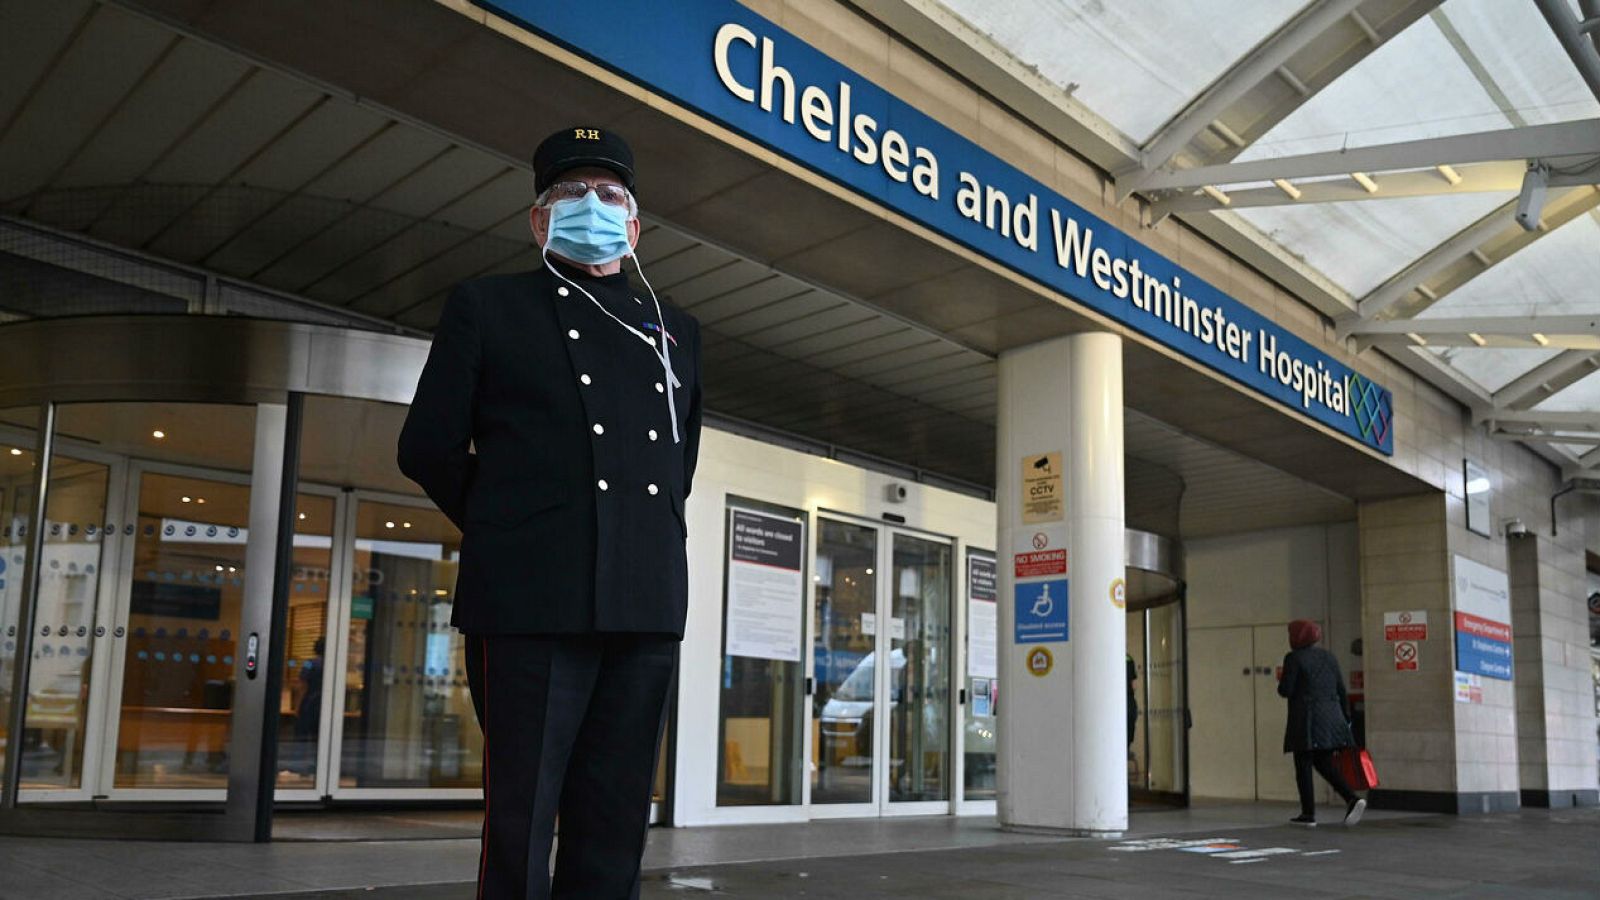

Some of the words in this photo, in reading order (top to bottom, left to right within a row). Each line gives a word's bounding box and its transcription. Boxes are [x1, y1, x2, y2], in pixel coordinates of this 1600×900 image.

[574, 128, 600, 140] RH
[713, 23, 940, 200] Chelsea
[957, 170, 1039, 252] and
[1050, 207, 1252, 365] Westminster
[1258, 329, 1352, 418] Hospital
[1030, 484, 1054, 496] CCTV
[1015, 556, 1027, 565] NO
[1029, 550, 1065, 562] SMOKING
